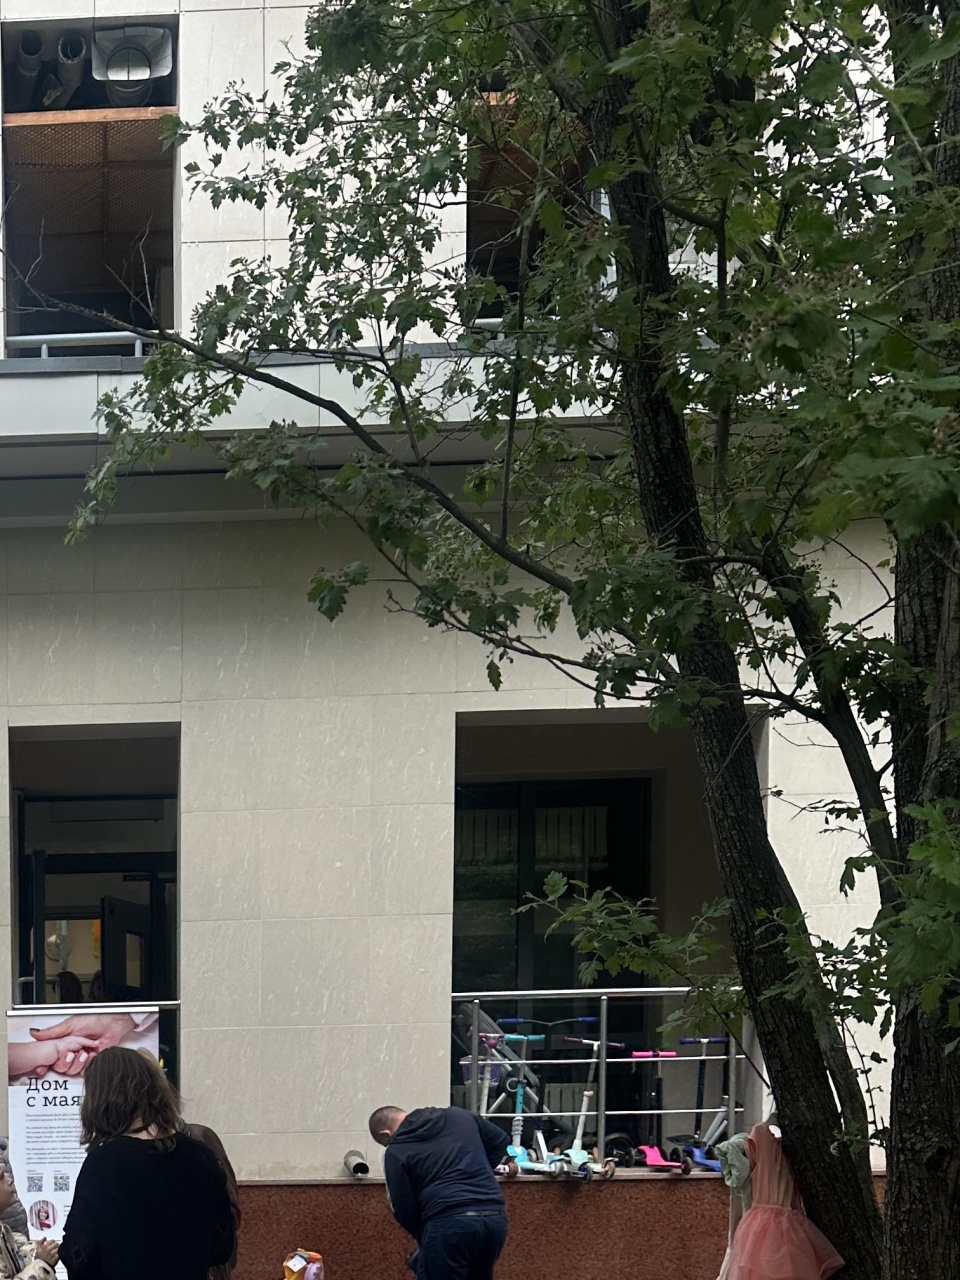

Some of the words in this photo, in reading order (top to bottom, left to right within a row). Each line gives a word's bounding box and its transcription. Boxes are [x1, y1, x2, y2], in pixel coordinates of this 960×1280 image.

[26, 1077, 69, 1094] Дом
[26, 1096, 36, 1108] с
[42, 1095, 83, 1107] мая
